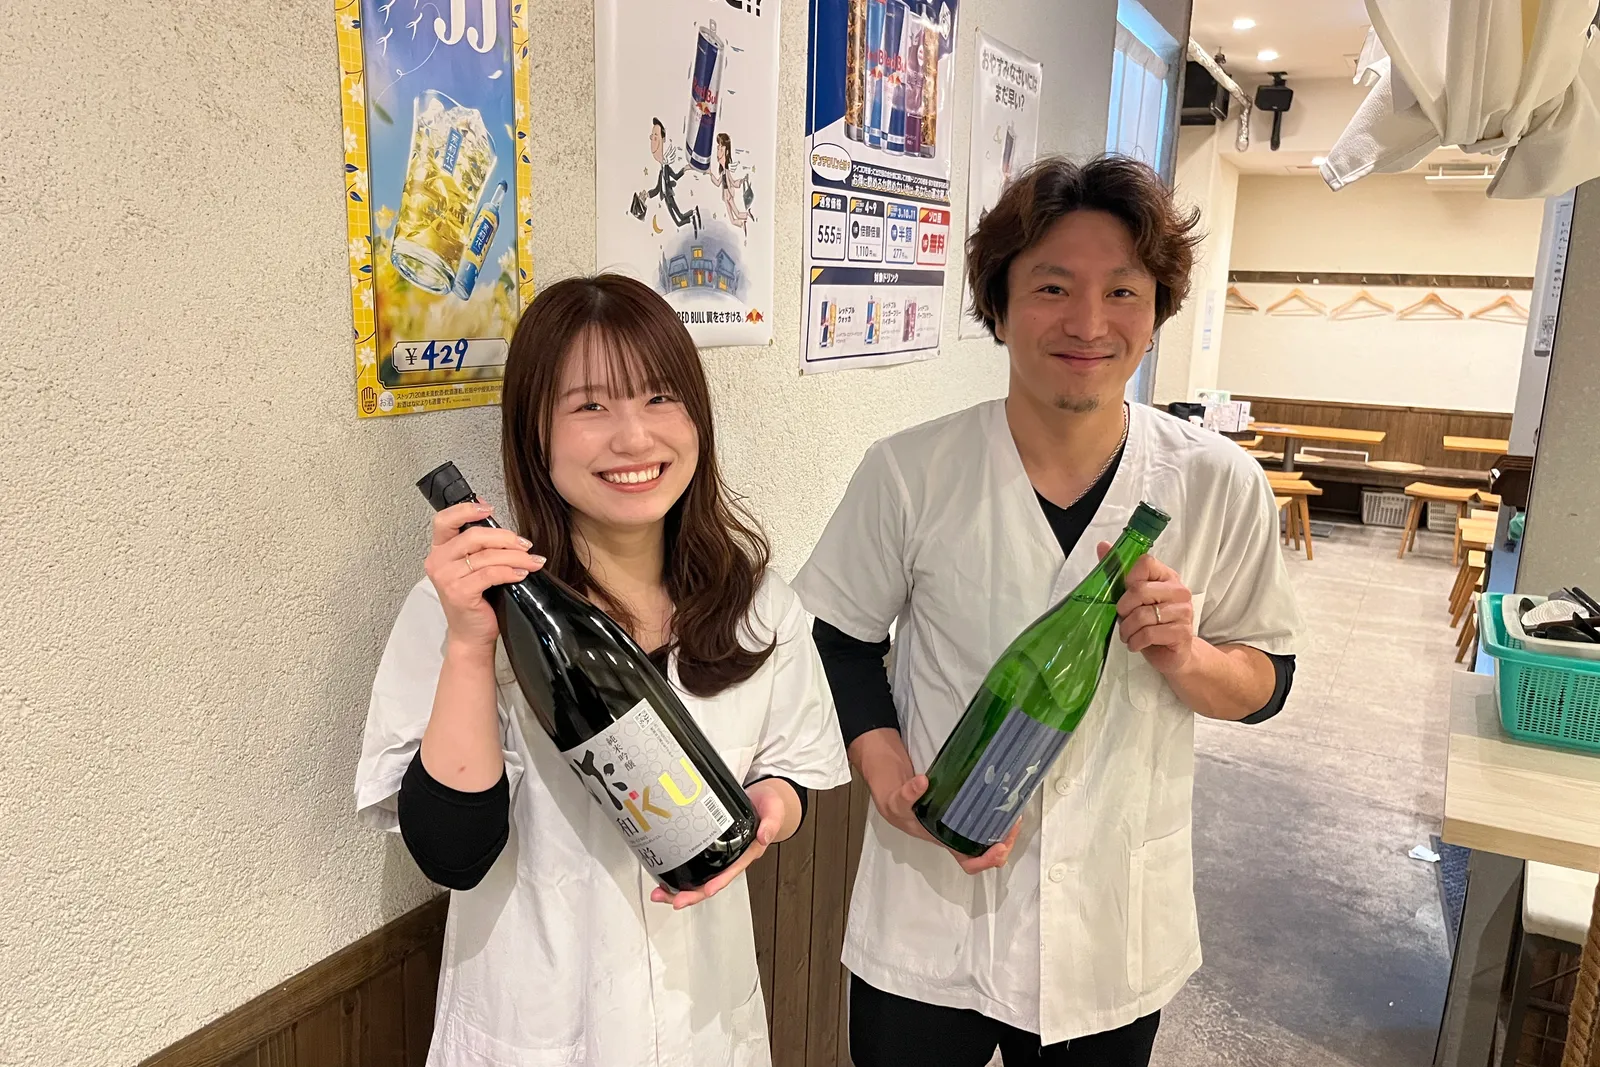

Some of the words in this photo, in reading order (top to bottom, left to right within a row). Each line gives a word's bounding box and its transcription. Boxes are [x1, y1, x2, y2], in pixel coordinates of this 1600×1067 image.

[898, 225, 912, 243] 半額
[929, 233, 945, 254] 無料
[691, 311, 705, 324] BULL
[606, 735, 636, 771] 純米吟醸
